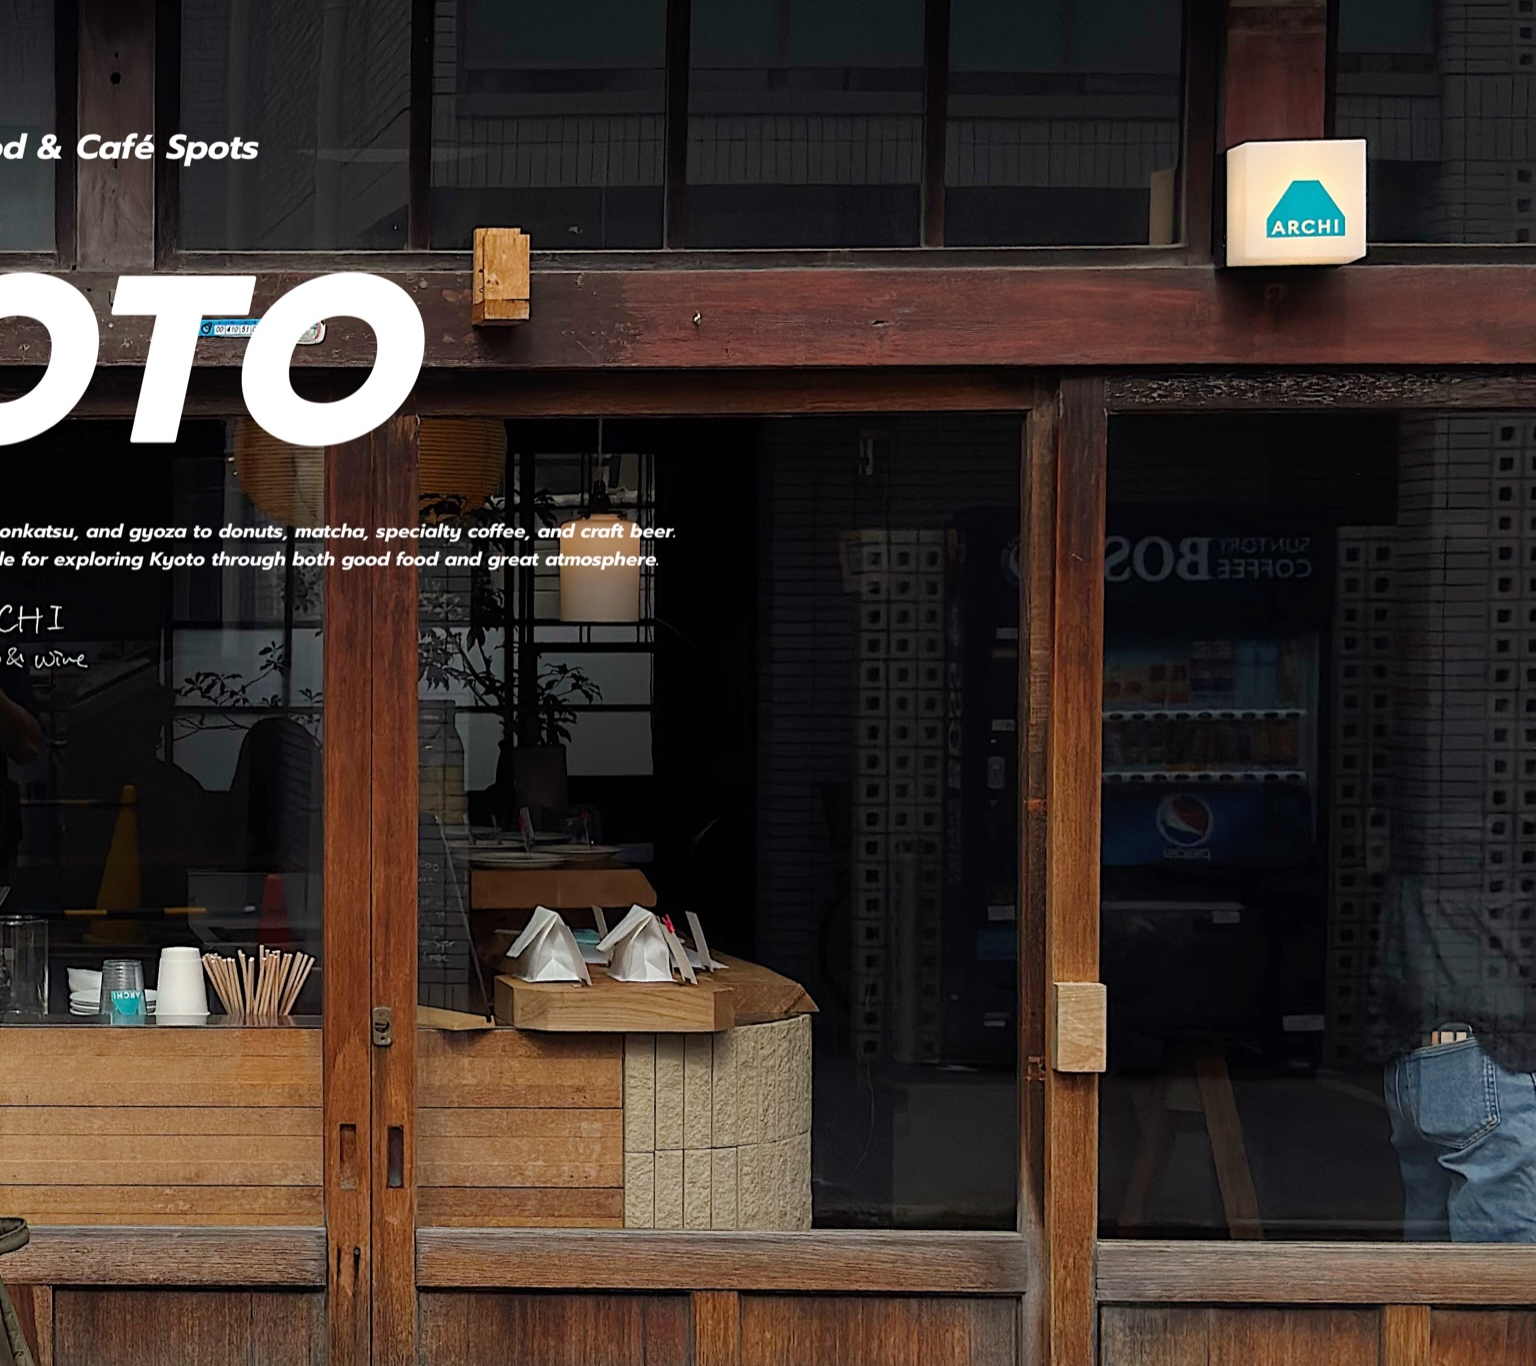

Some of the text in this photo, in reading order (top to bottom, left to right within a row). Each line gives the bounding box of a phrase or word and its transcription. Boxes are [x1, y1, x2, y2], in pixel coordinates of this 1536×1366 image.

[1271, 219, 1340, 236] ARCHI
[34, 650, 89, 669] wine
[113, 990, 141, 1000] ARCHI
